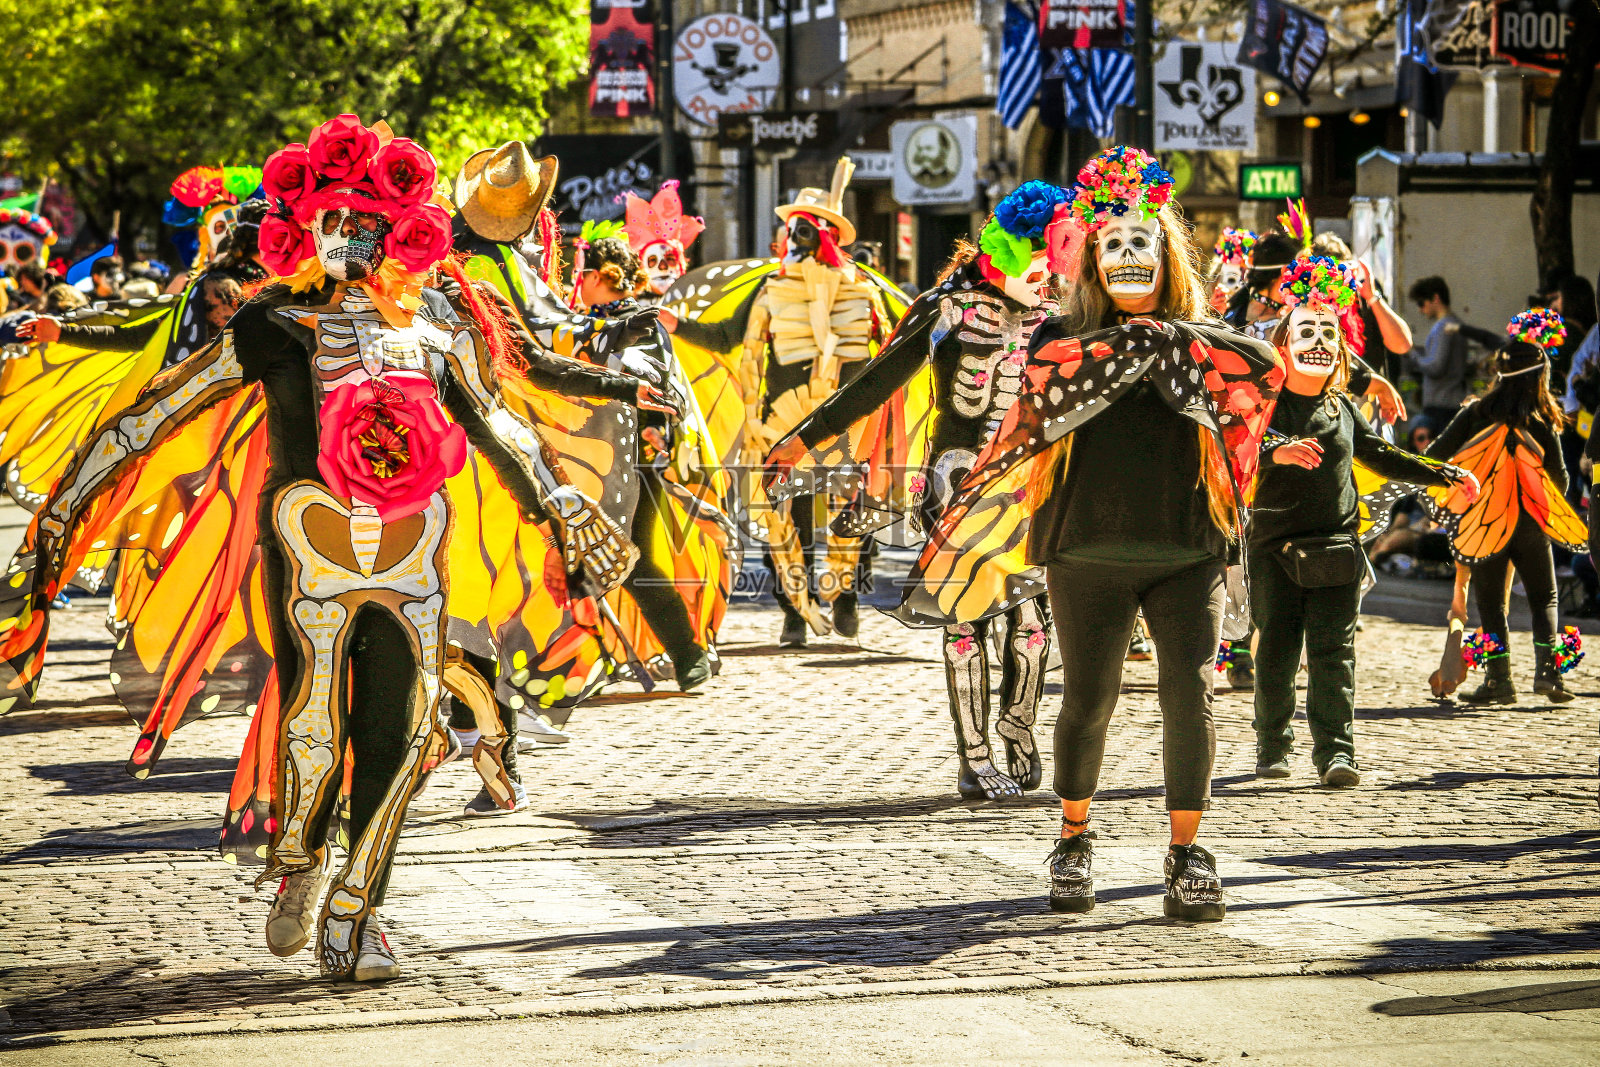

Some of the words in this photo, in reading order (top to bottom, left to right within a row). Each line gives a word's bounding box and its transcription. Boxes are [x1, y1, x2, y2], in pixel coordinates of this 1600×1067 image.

[1046, 9, 1118, 29] PINK
[675, 17, 774, 62] VOODOO
[596, 88, 648, 103] PINK
[749, 113, 819, 146] Touché
[560, 158, 653, 211] Pete's
[1246, 169, 1297, 194] ATM
